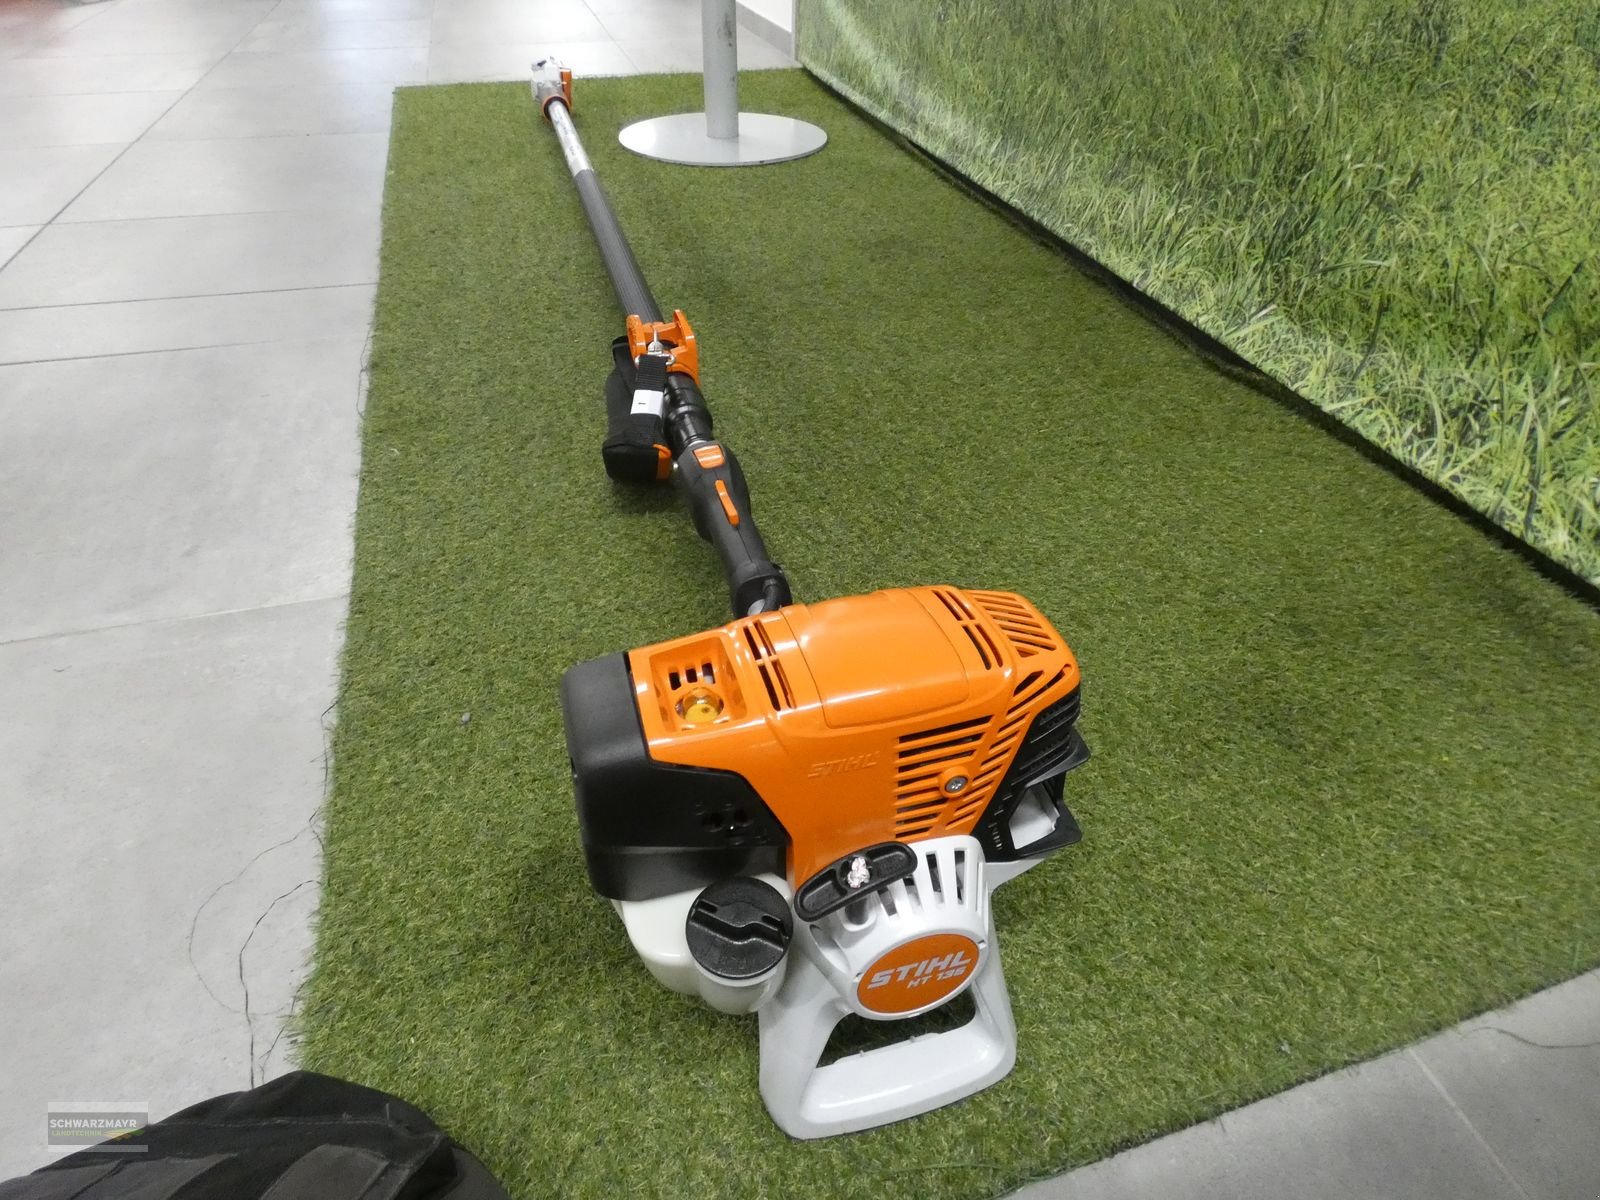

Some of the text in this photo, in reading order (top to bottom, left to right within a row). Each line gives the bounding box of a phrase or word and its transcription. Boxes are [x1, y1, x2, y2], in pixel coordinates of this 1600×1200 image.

[808, 753, 878, 778] STIHL
[867, 951, 972, 990] STIHL
[907, 975, 933, 989] HT
